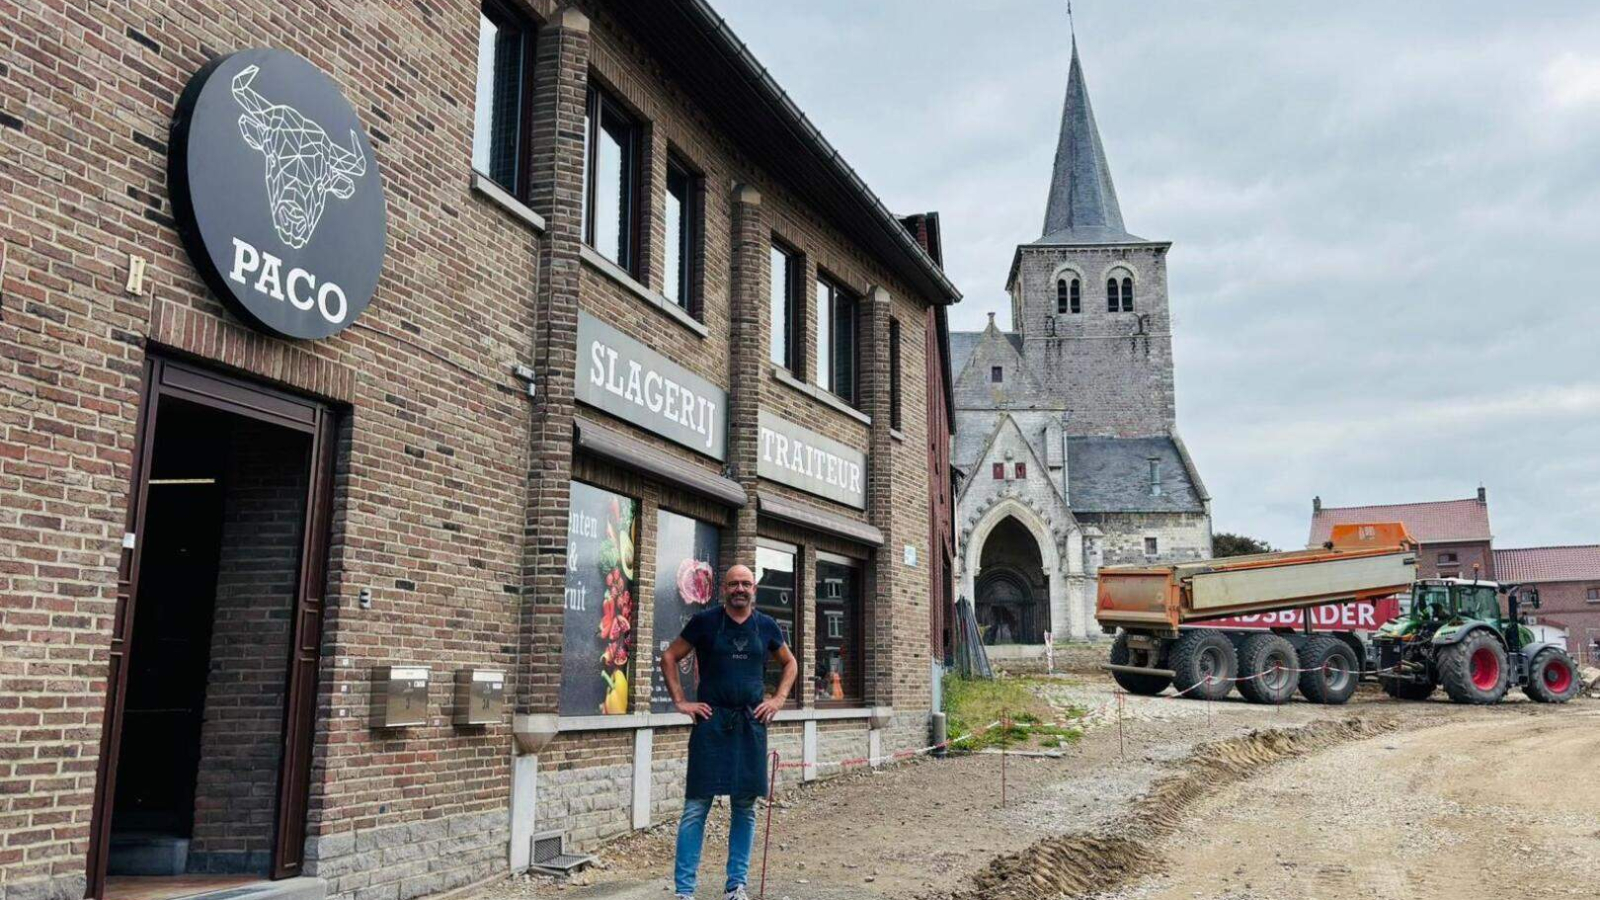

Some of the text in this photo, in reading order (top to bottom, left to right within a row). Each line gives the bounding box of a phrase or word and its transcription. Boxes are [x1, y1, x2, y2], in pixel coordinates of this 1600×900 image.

[230, 237, 348, 324] PACO
[590, 339, 716, 448] SLAGERIJ
[761, 427, 862, 495] TRAITEUR
[569, 541, 578, 571] &
